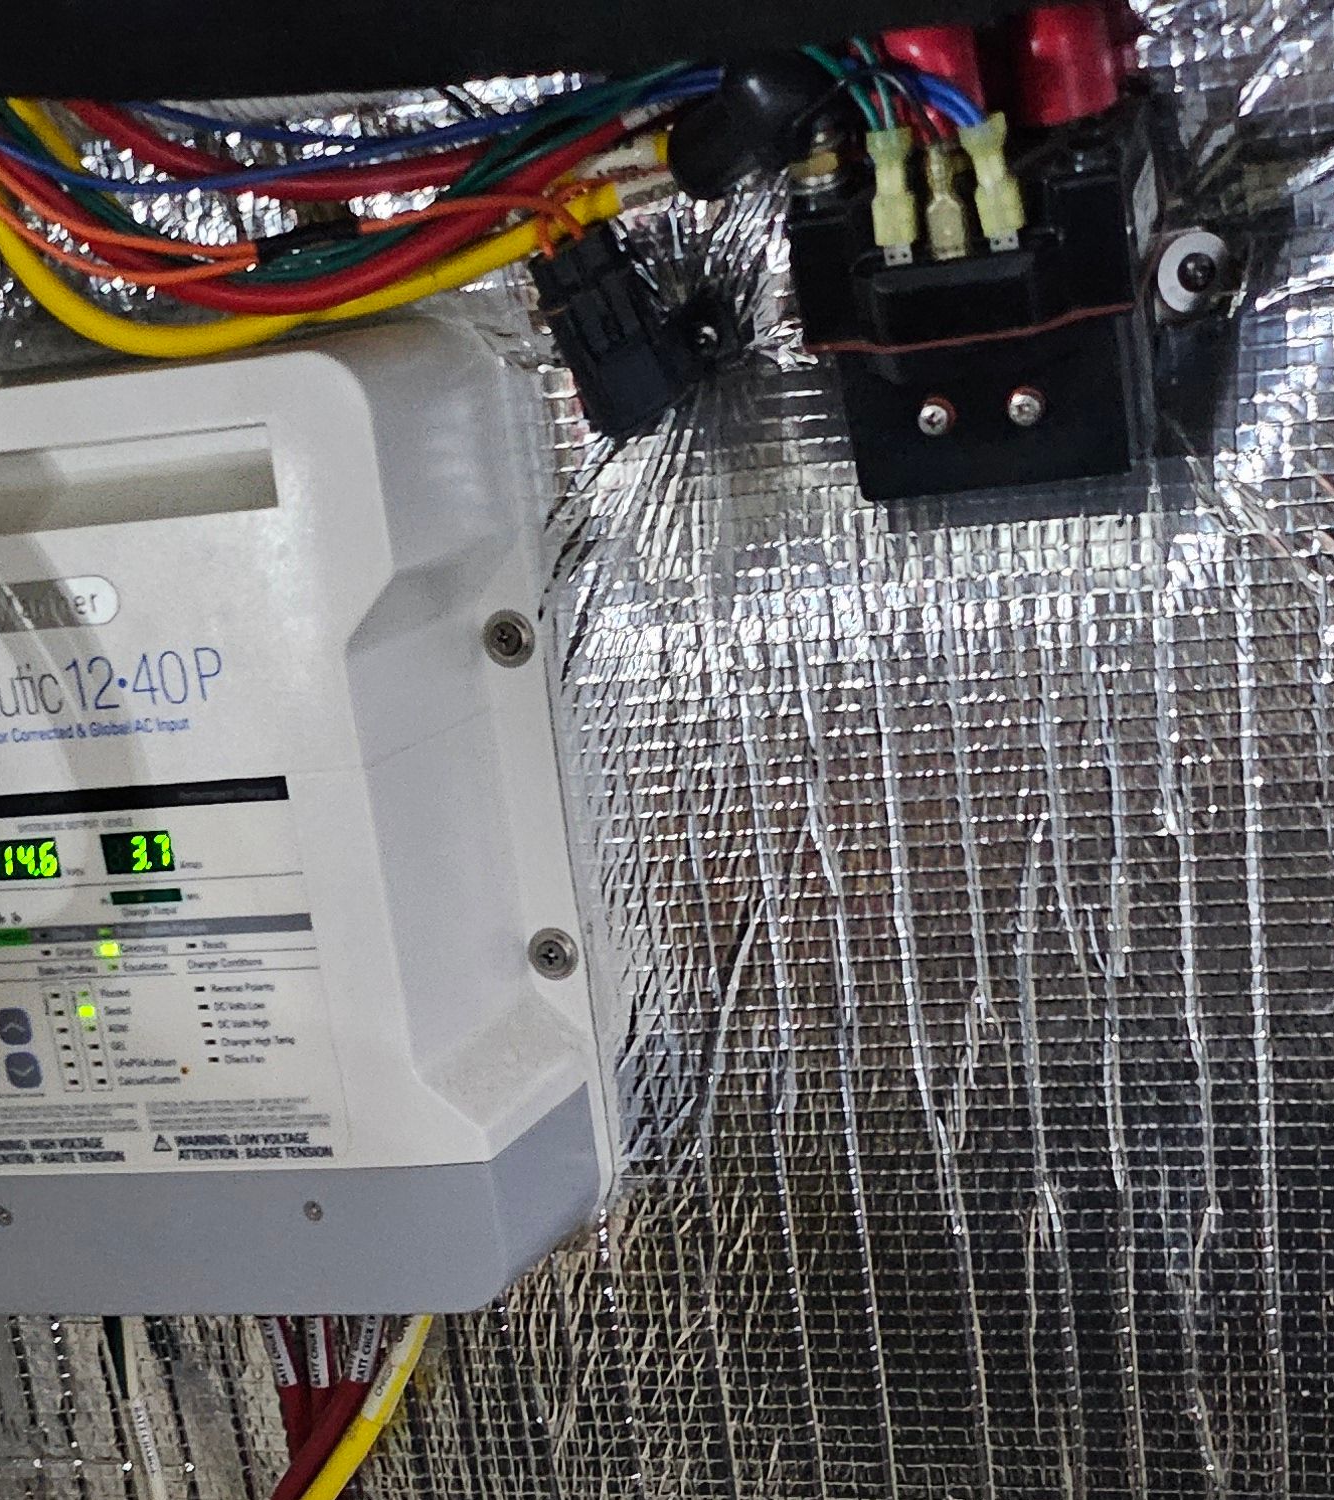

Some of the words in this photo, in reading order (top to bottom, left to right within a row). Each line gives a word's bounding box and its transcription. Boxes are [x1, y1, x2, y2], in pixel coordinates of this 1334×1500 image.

[12, 726, 73, 743] Corrected
[77, 722, 86, 738] &
[91, 720, 132, 738] Global
[135, 717, 153, 733] AC
[157, 717, 190, 733] Input
[4, 841, 58, 878] 14.6
[131, 834, 170, 871] 3.7
[187, 959, 218, 970] Charger
[220, 958, 263, 969] Conditions
[29, 1137, 57, 1150] HIGH
[58, 1135, 105, 1149] VOLTAGE
[174, 1133, 233, 1148] WARNING:
[233, 1132, 262, 1146] LOW
[262, 1131, 310, 1146] VOLTAGE
[42, 1151, 78, 1164] HAUTE
[79, 1149, 126, 1163] TENSION
[247, 1146, 286, 1160] BASSE
[286, 1144, 335, 1159] TENSION
